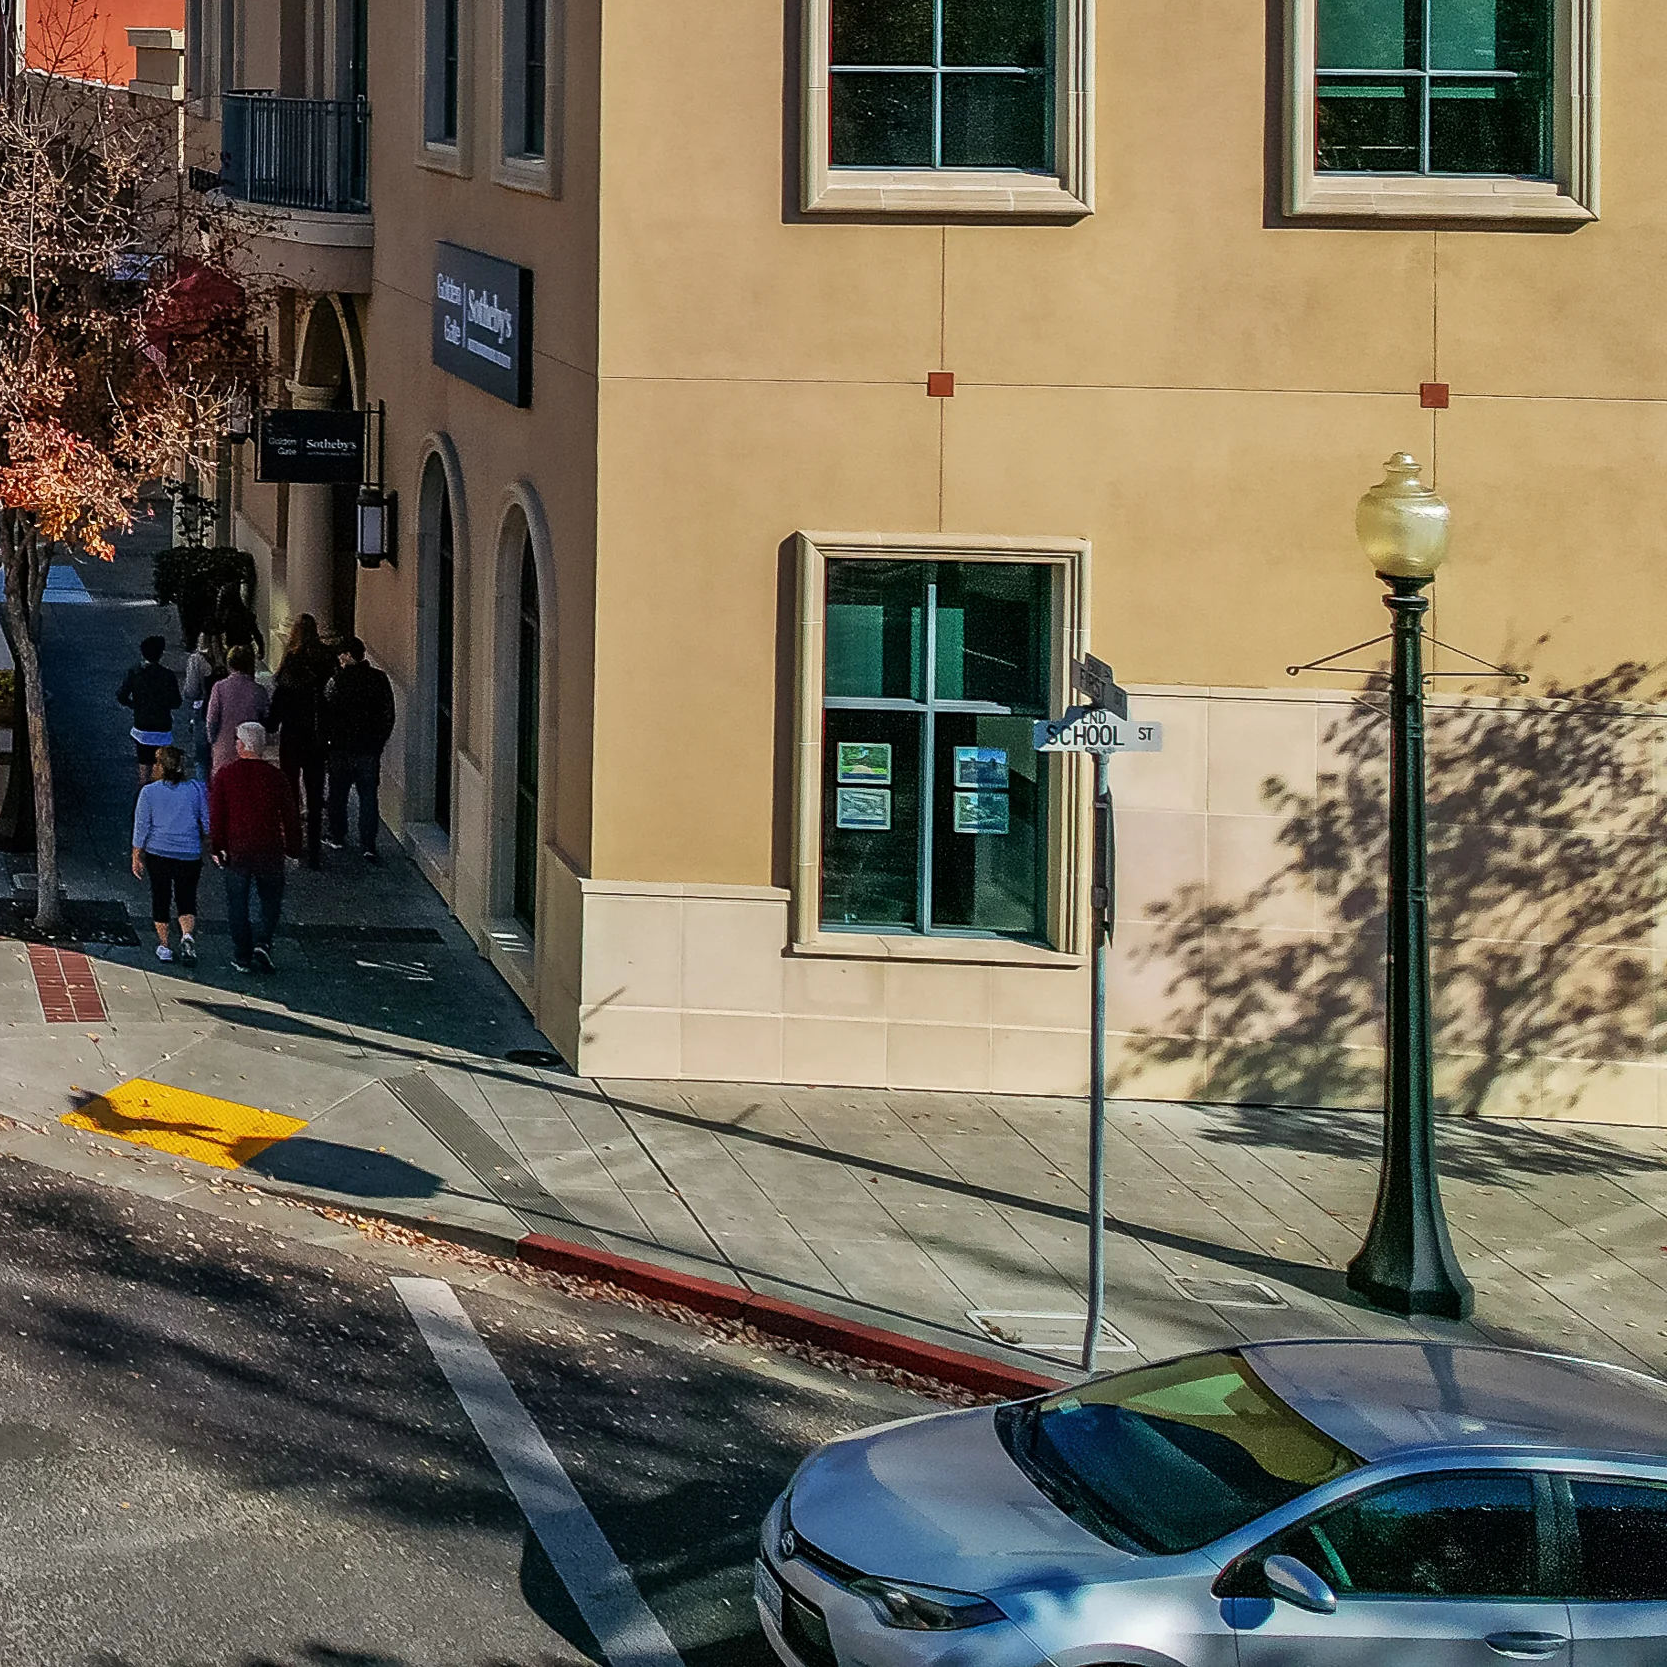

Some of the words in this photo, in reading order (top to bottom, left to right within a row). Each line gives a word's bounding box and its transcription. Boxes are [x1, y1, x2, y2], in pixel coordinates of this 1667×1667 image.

[306, 438, 357, 451] Sotheby's
[1081, 710, 1107, 725] END
[1046, 724, 1125, 746] SCHOOL
[1138, 727, 1154, 741] ST
